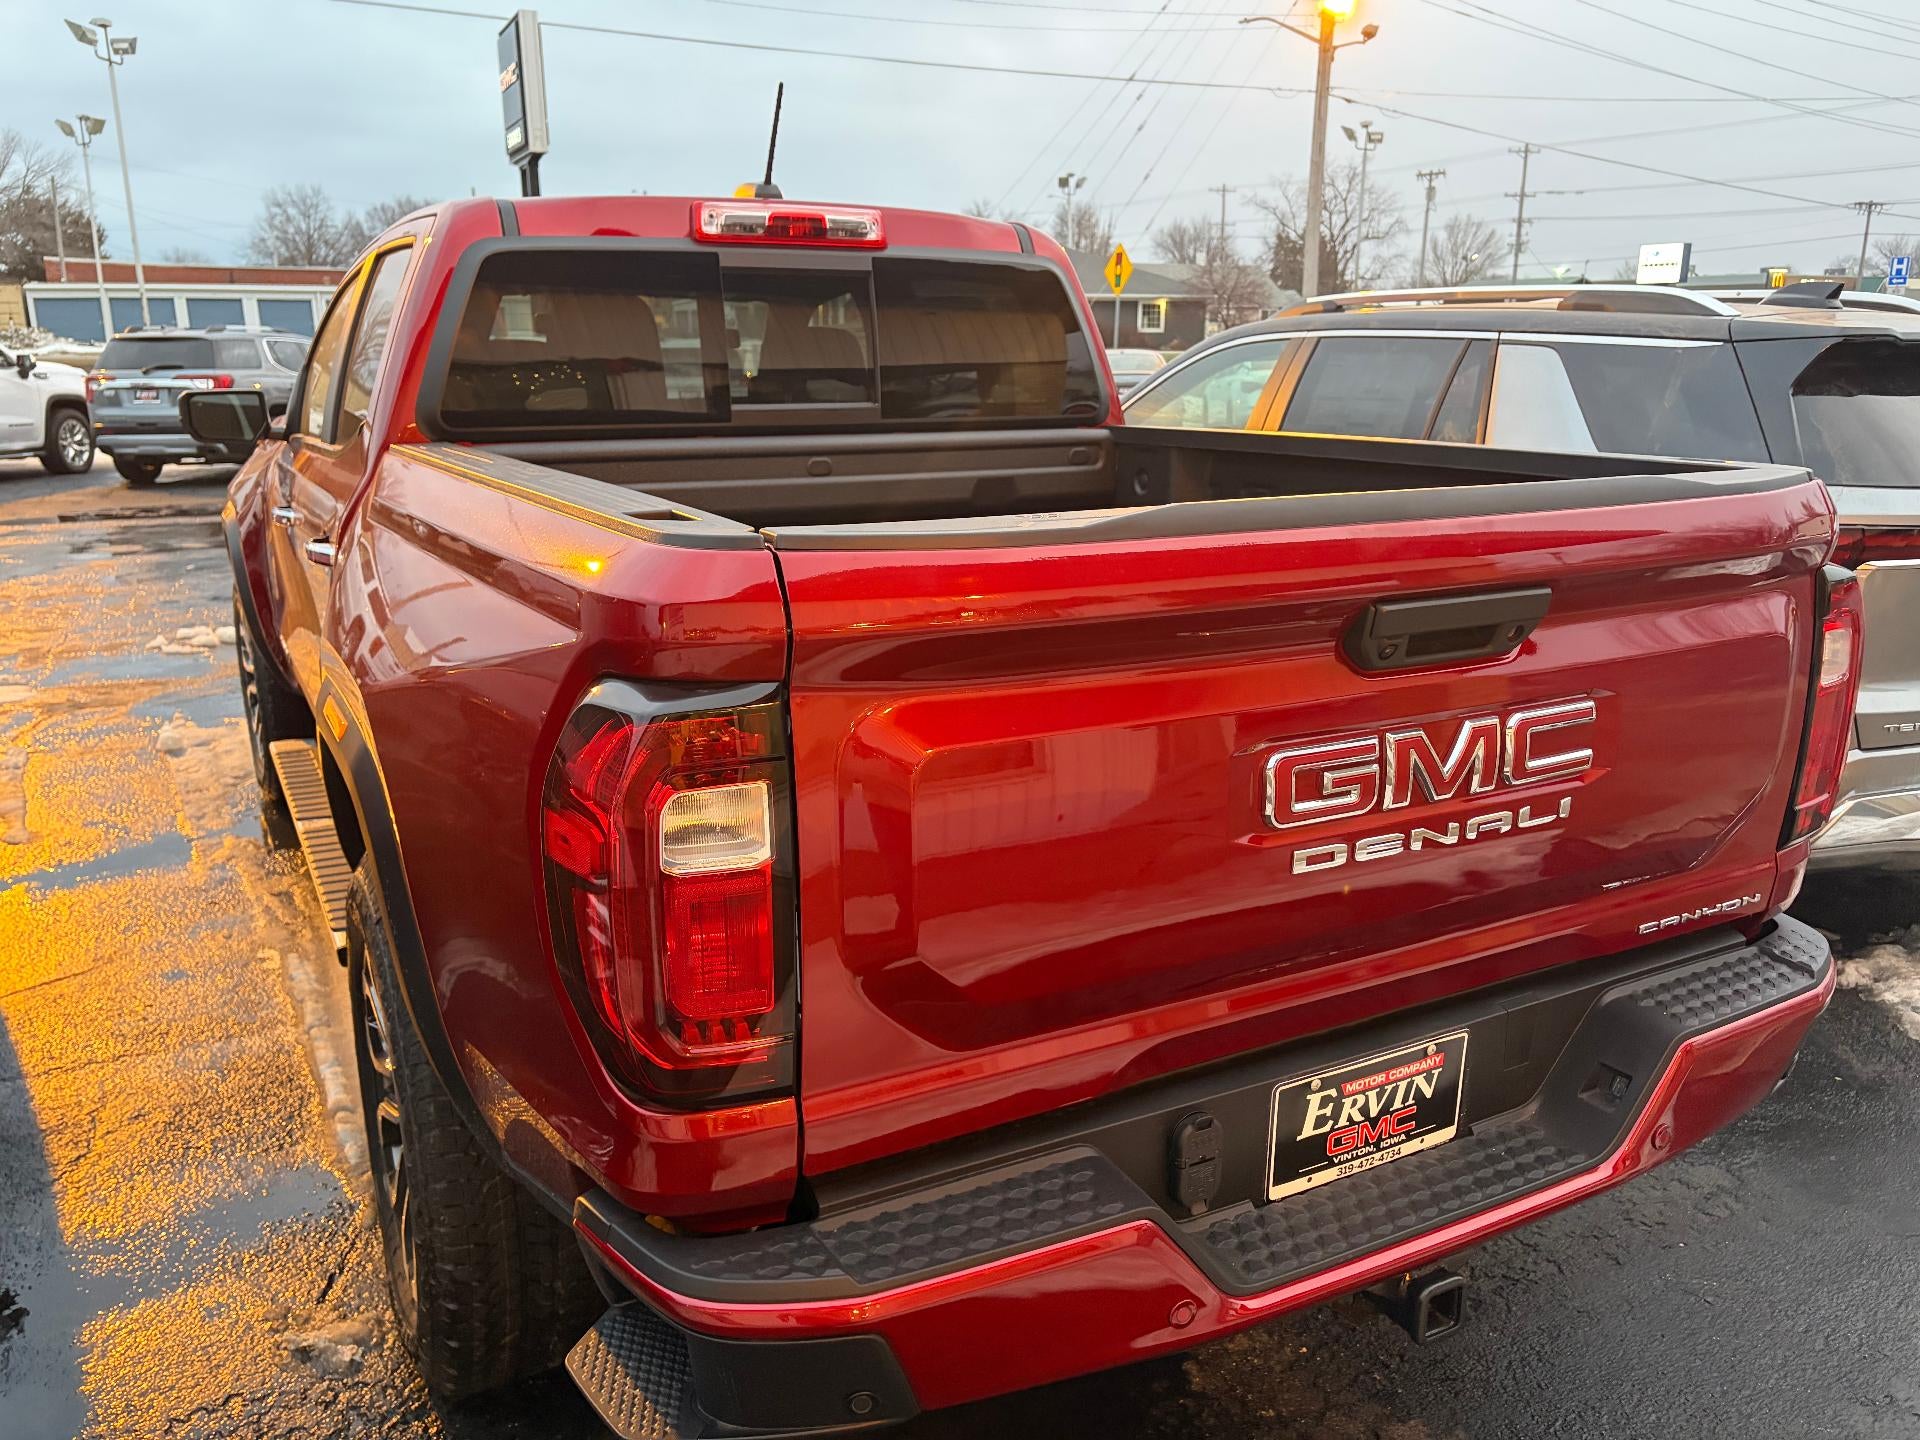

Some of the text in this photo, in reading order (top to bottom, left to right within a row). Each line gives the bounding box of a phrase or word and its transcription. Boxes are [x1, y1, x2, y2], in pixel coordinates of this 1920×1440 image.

[1892, 258, 1907, 276] H
[1265, 699, 1597, 829] GMC
[1291, 796, 1572, 875] DENALI
[1638, 893, 1761, 935] CANYON
[1345, 1054, 1442, 1093] MOTOR COMPANY
[1296, 1067, 1443, 1141] ERVIN
[1326, 1105, 1417, 1157] GMC
[1332, 1145, 1377, 1164] VINTON,
[1380, 1134, 1407, 1148] IOWA
[1336, 1150, 1402, 1177] 319-472-4734
